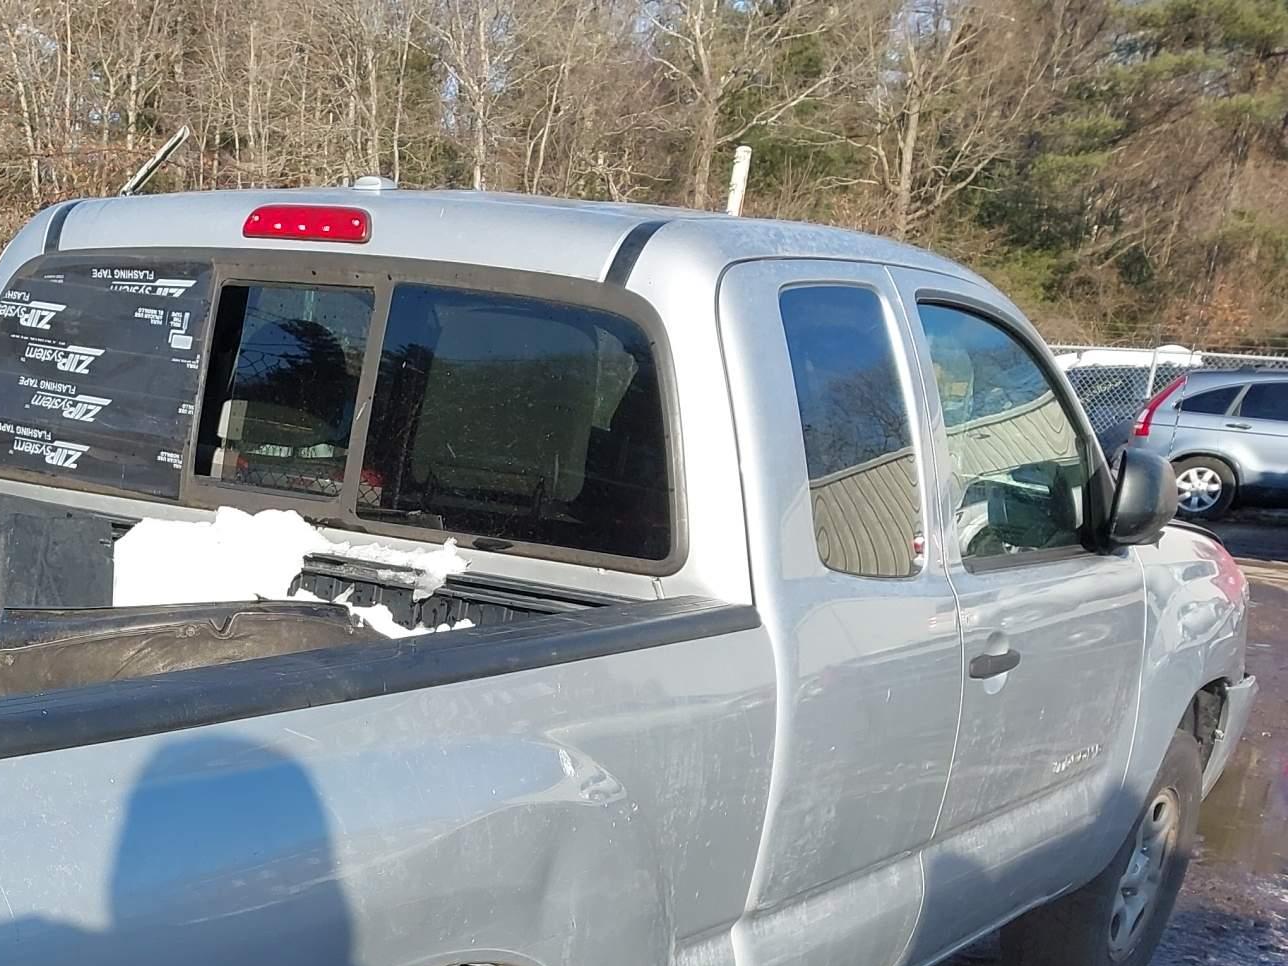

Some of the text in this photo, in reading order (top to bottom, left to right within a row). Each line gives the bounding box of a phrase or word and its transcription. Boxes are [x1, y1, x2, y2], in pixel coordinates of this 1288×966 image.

[92, 268, 155, 280] FLASHING TAPE
[18, 375, 77, 395] FLASHING TAPE
[16, 426, 52, 441] FLASHING
